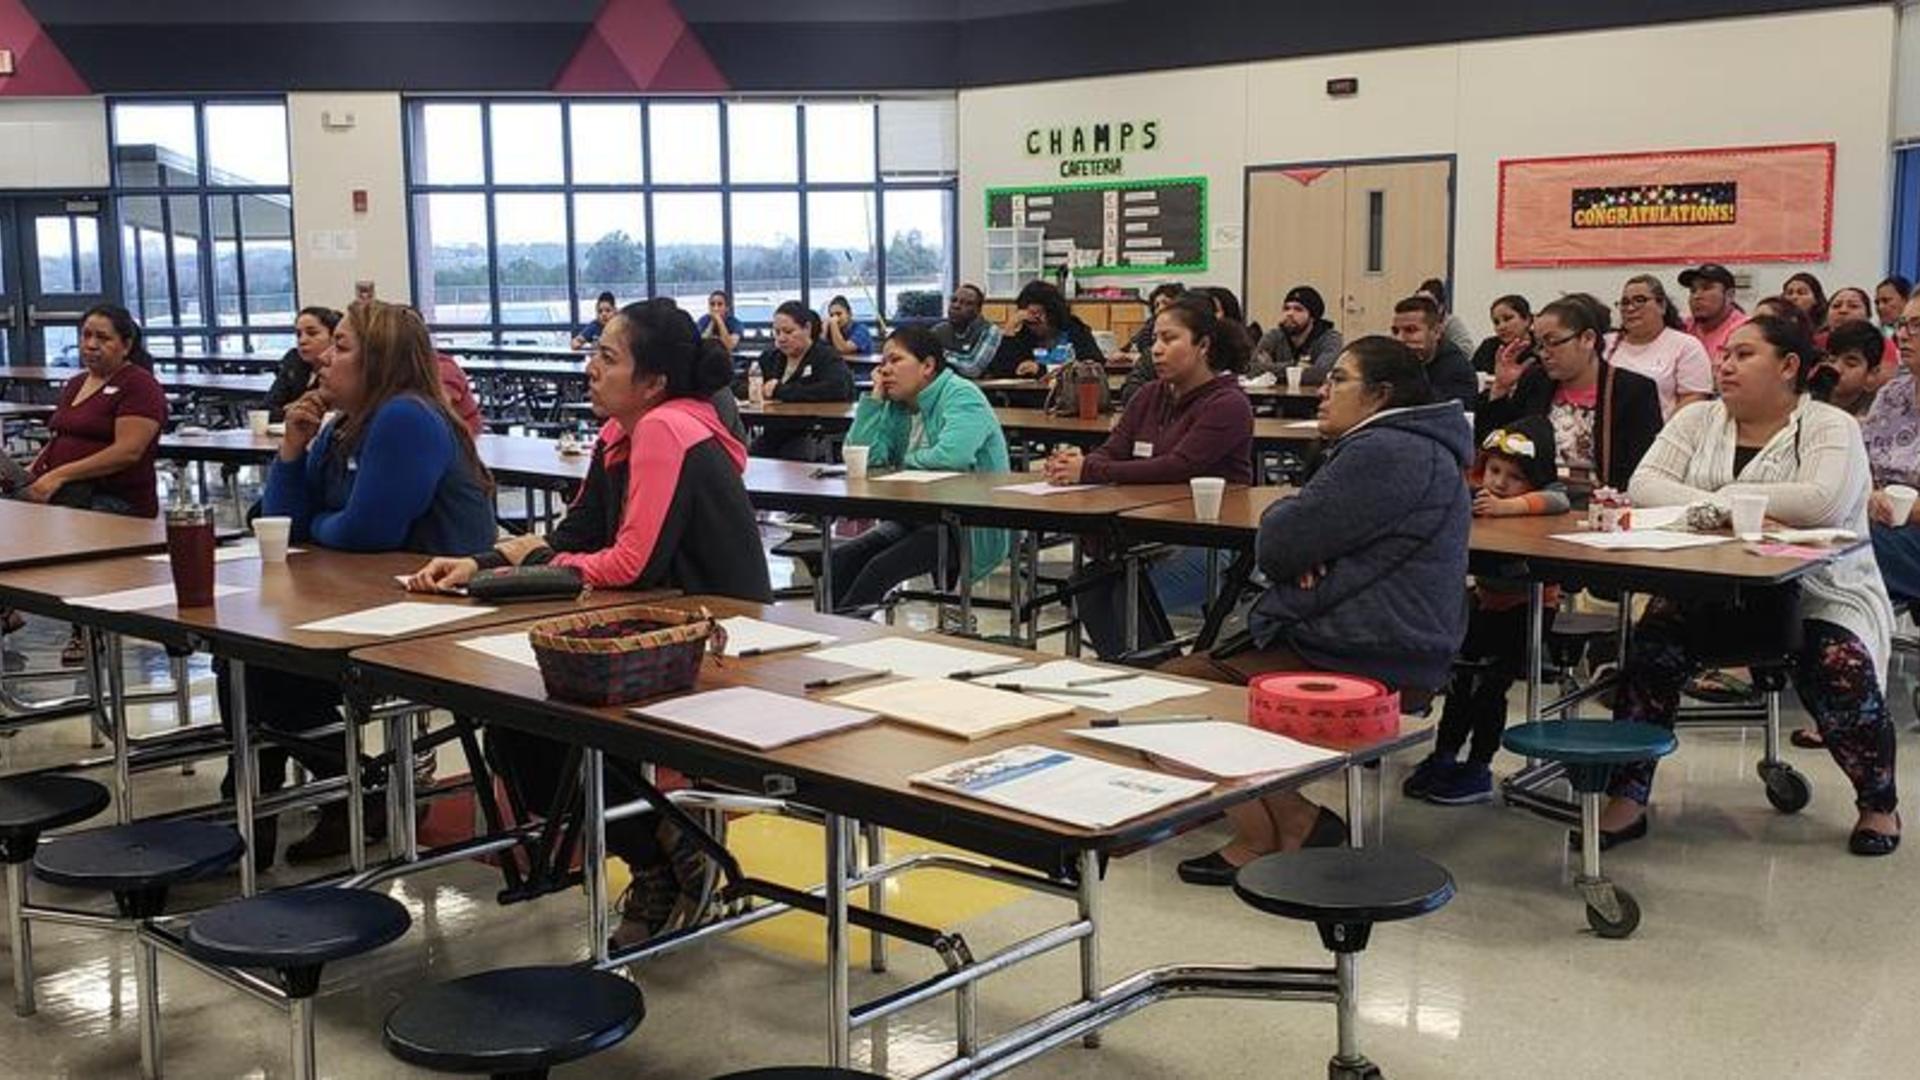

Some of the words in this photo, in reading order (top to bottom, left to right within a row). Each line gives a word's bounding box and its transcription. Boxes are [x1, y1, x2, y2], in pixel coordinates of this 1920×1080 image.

[1027, 122, 1157, 154] CHAMPS
[1060, 158, 1122, 178] CAFETERIA
[1575, 205, 1735, 226] CONGRATULATIONS!
